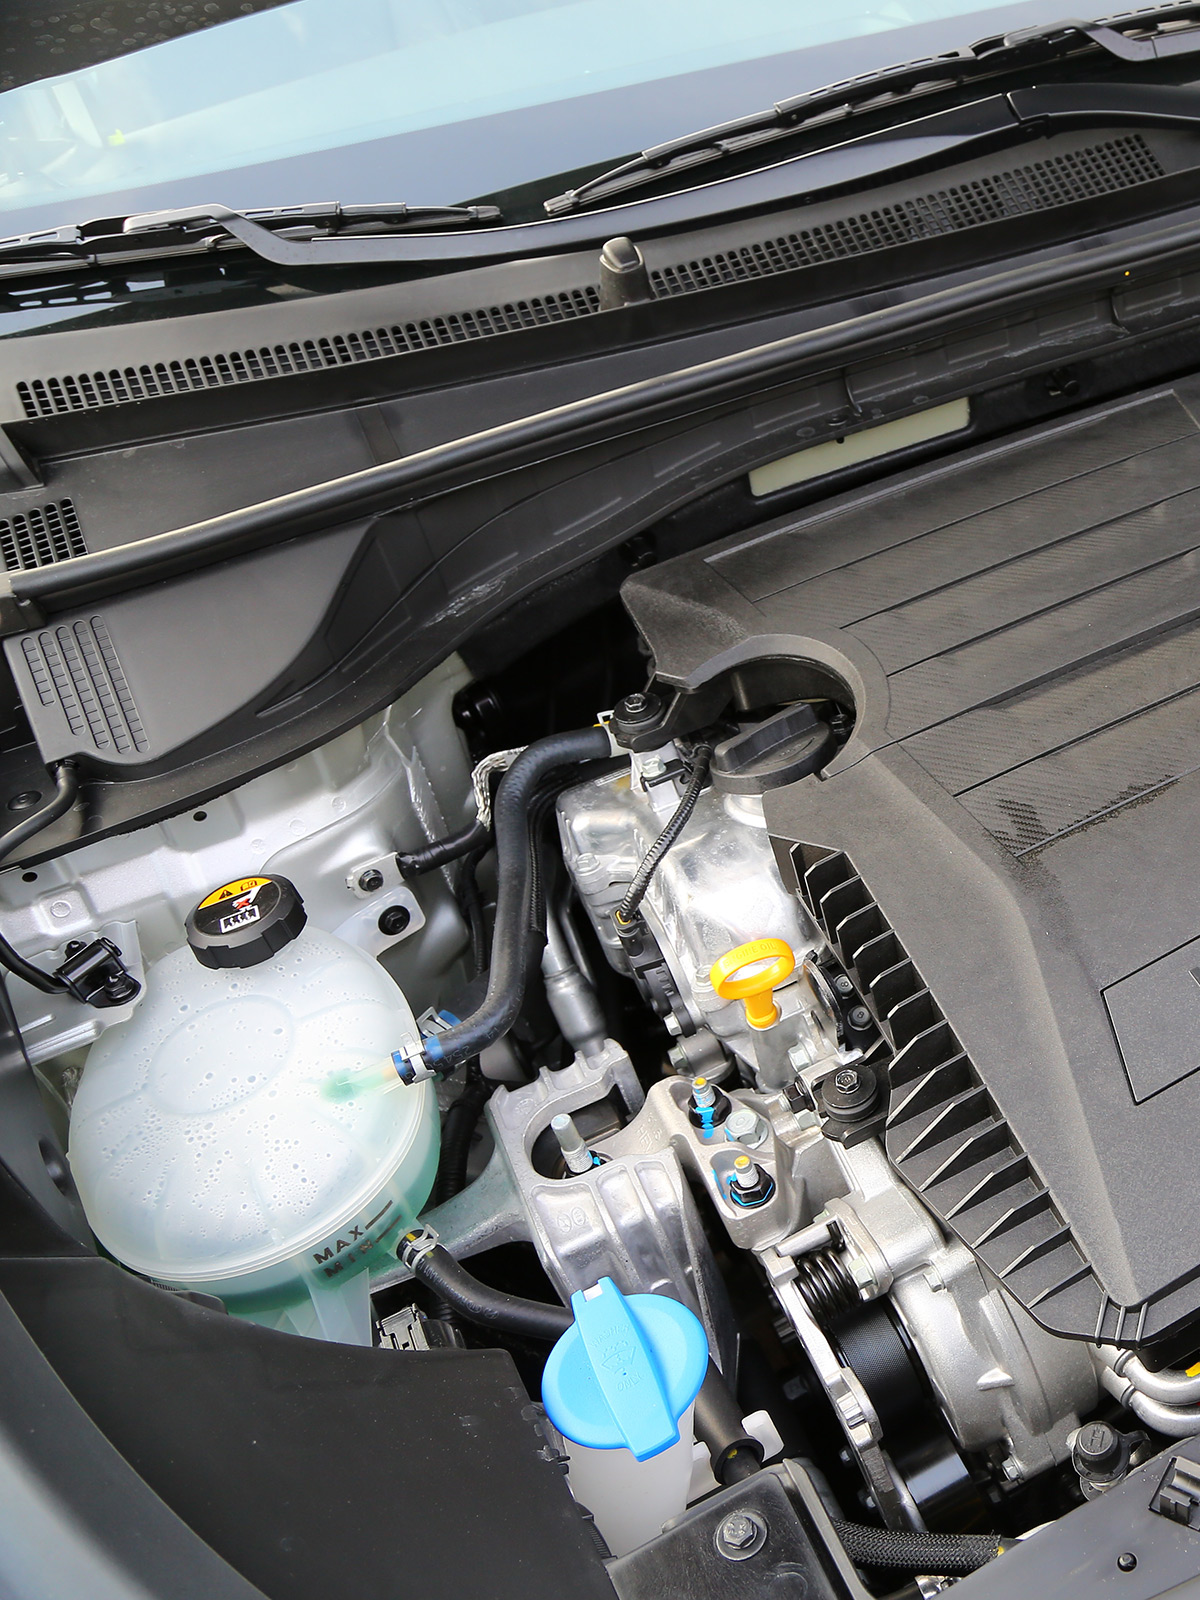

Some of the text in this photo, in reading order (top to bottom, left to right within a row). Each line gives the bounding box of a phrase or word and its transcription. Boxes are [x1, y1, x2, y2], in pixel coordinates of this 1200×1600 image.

[759, 942, 778, 951] OIL
[312, 1224, 364, 1265] MAX
[323, 1239, 375, 1278] MIN
[616, 1374, 644, 1392] ONLY
[1090, 1429, 1106, 1448] H
